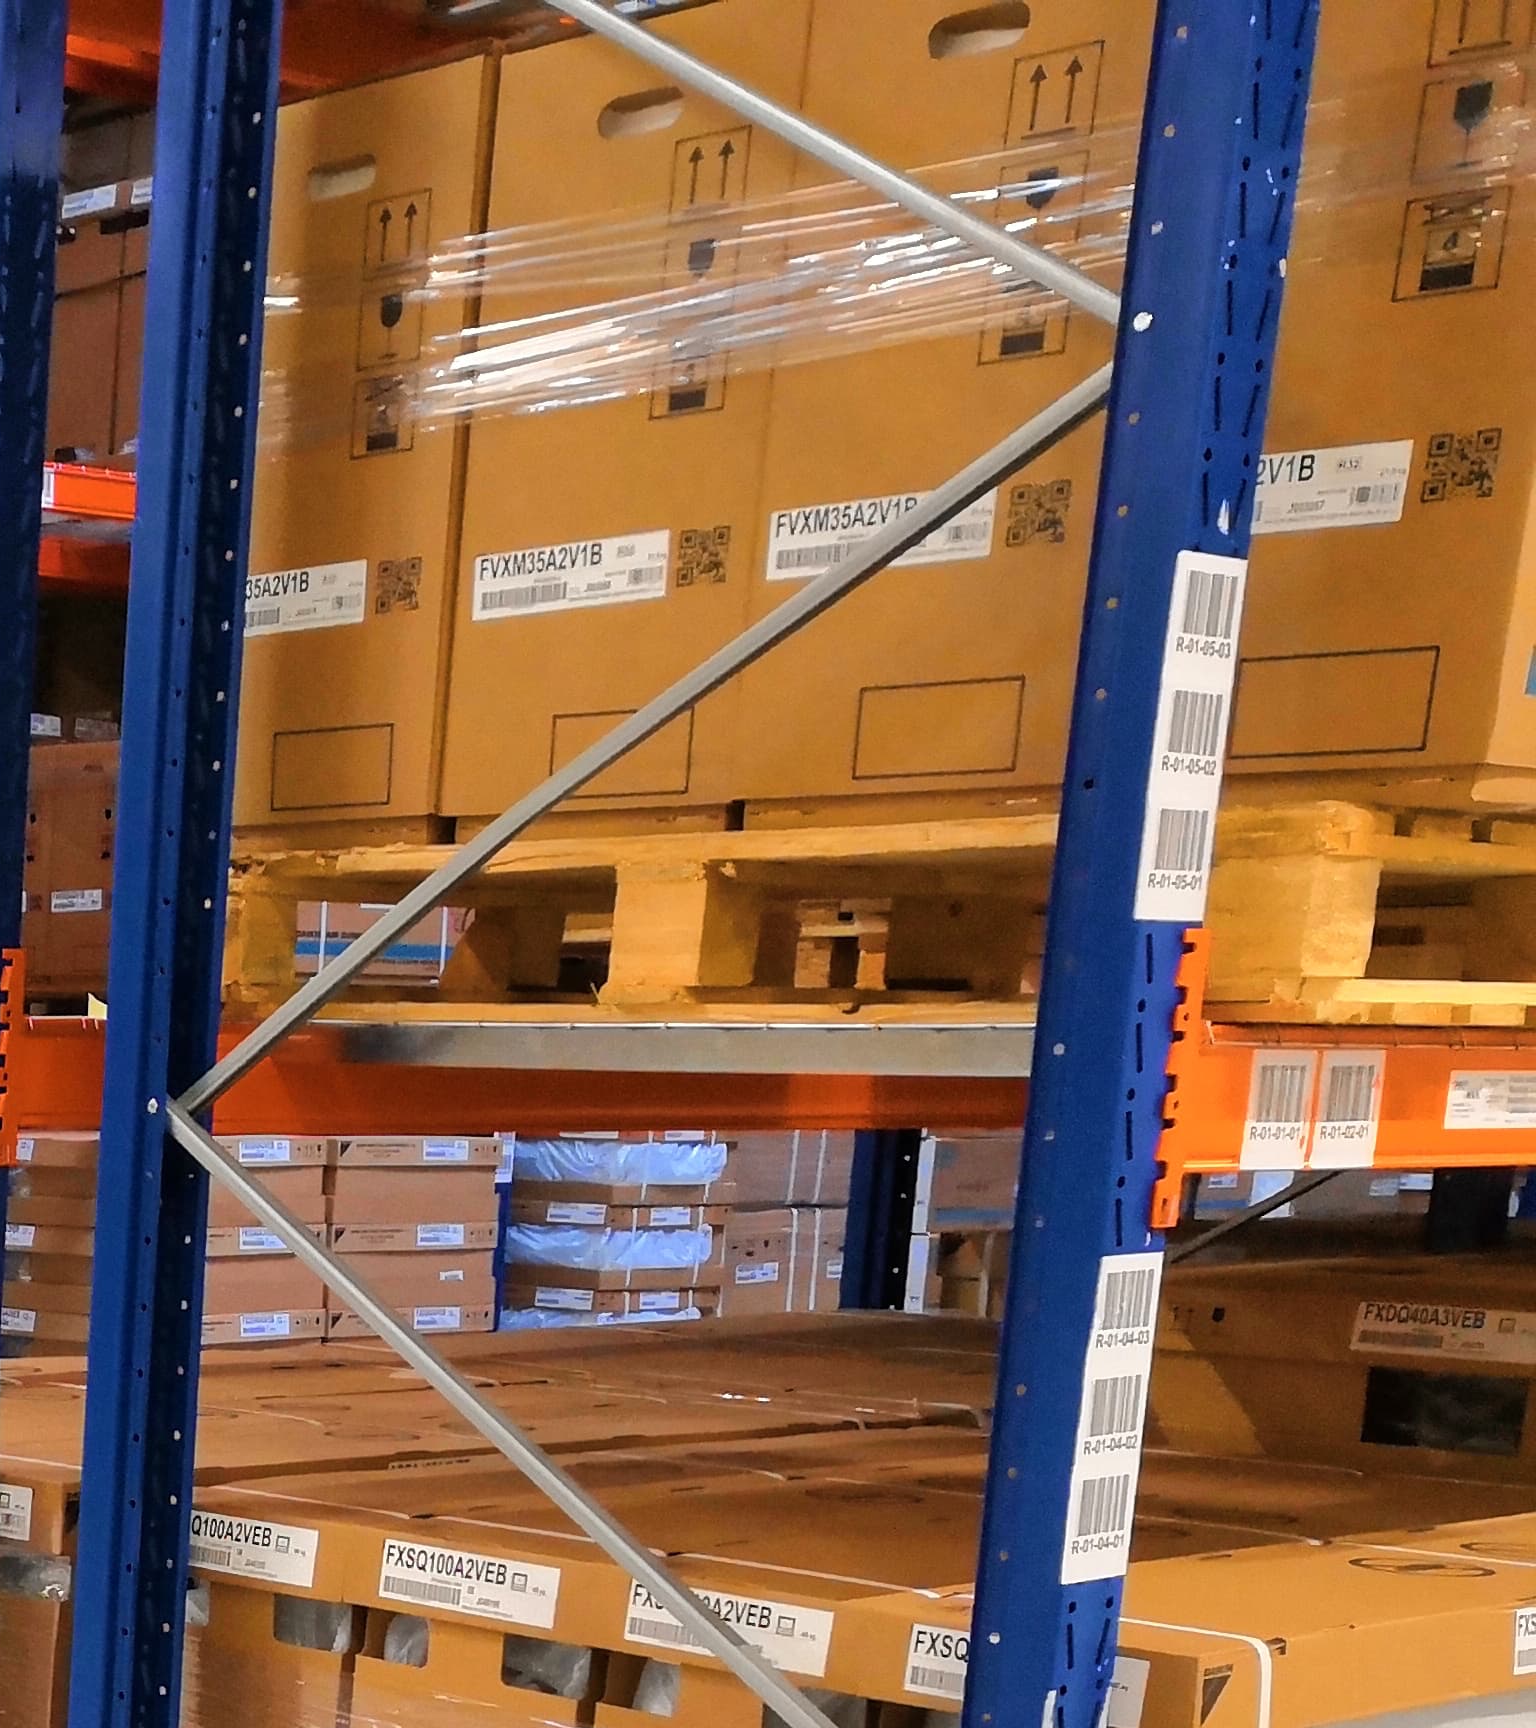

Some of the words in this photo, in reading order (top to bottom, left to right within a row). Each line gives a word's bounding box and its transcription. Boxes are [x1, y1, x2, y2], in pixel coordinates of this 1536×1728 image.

[480, 543, 602, 580] FVXM35A2V1B
[1176, 636, 1231, 659] R-01-05-03
[1161, 755, 1216, 776] R-01-05-02
[1147, 873, 1202, 890] R-01-05-01
[1250, 1126, 1301, 1141] R-01-01-01
[1320, 1125, 1369, 1140] R-01-02-01
[1363, 1303, 1486, 1329] FXDQ40A3VEB
[1095, 1329, 1150, 1349] R-01-04-03
[1083, 1434, 1138, 1455] R-01-04-02
[1071, 1534, 1125, 1554] R-01-04-01
[386, 1544, 507, 1585] FXSQ100A2VEB
